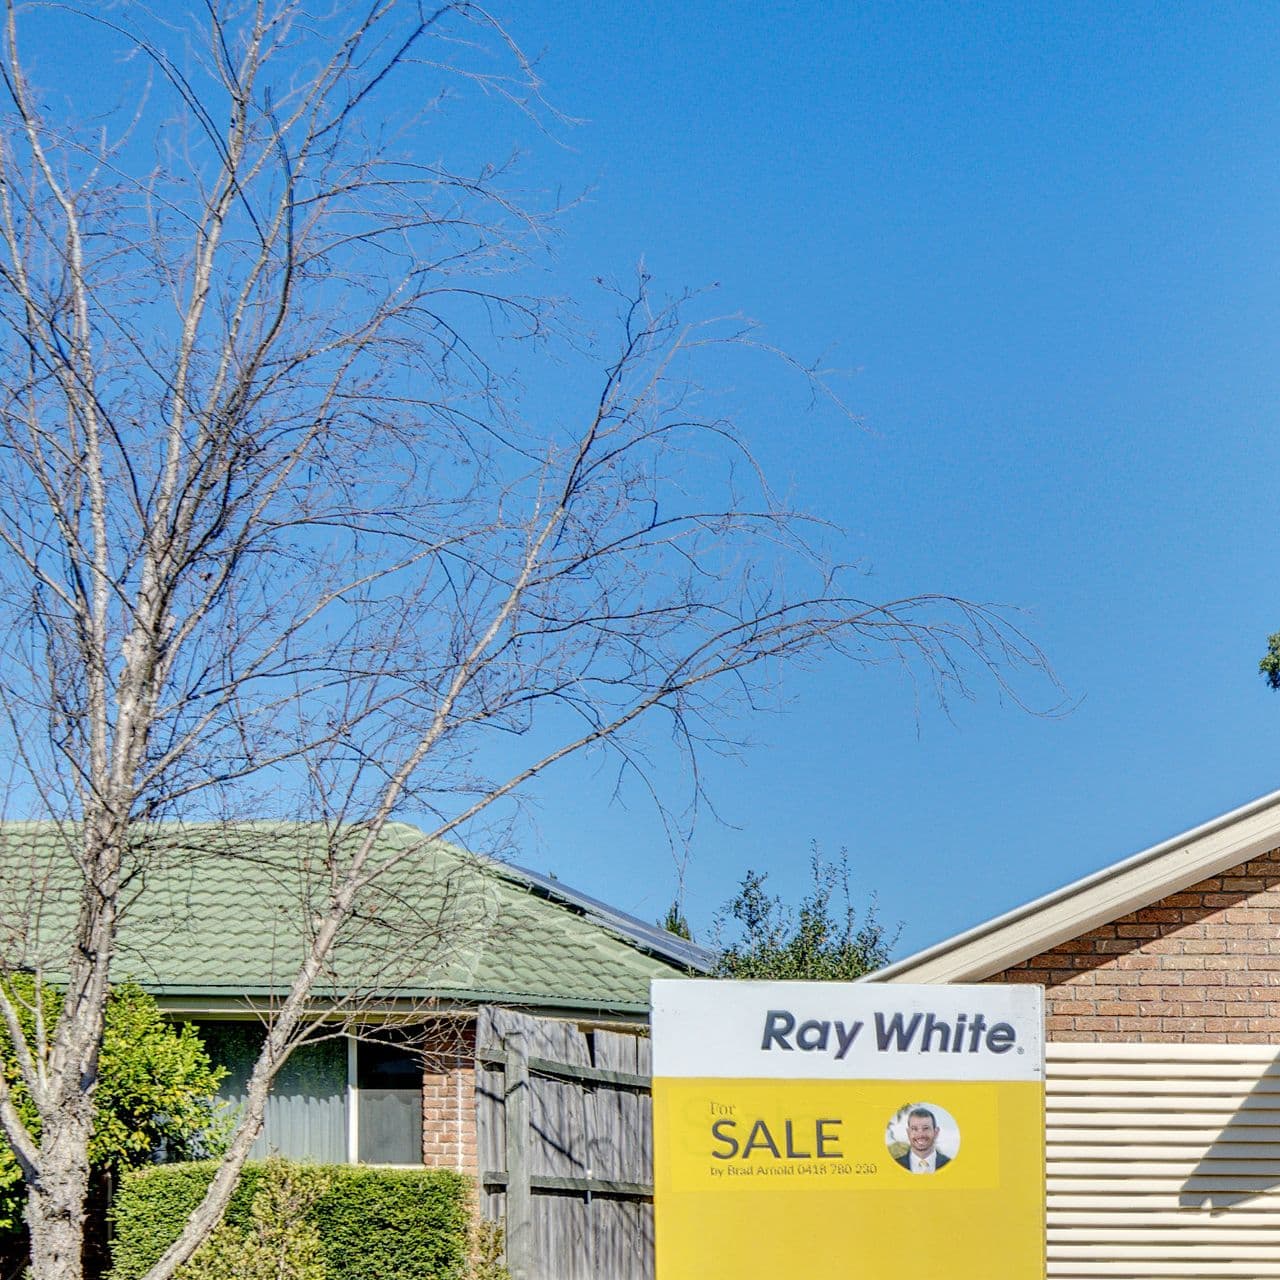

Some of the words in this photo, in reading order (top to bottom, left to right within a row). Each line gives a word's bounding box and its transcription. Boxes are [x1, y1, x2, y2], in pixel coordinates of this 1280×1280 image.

[761, 1010, 864, 1060] Ray
[710, 1102, 736, 1117] For
[711, 1119, 844, 1160] SALE
[710, 1166, 724, 1177] by
[728, 1165, 753, 1176] Brad
[757, 1165, 794, 1176] Arnold
